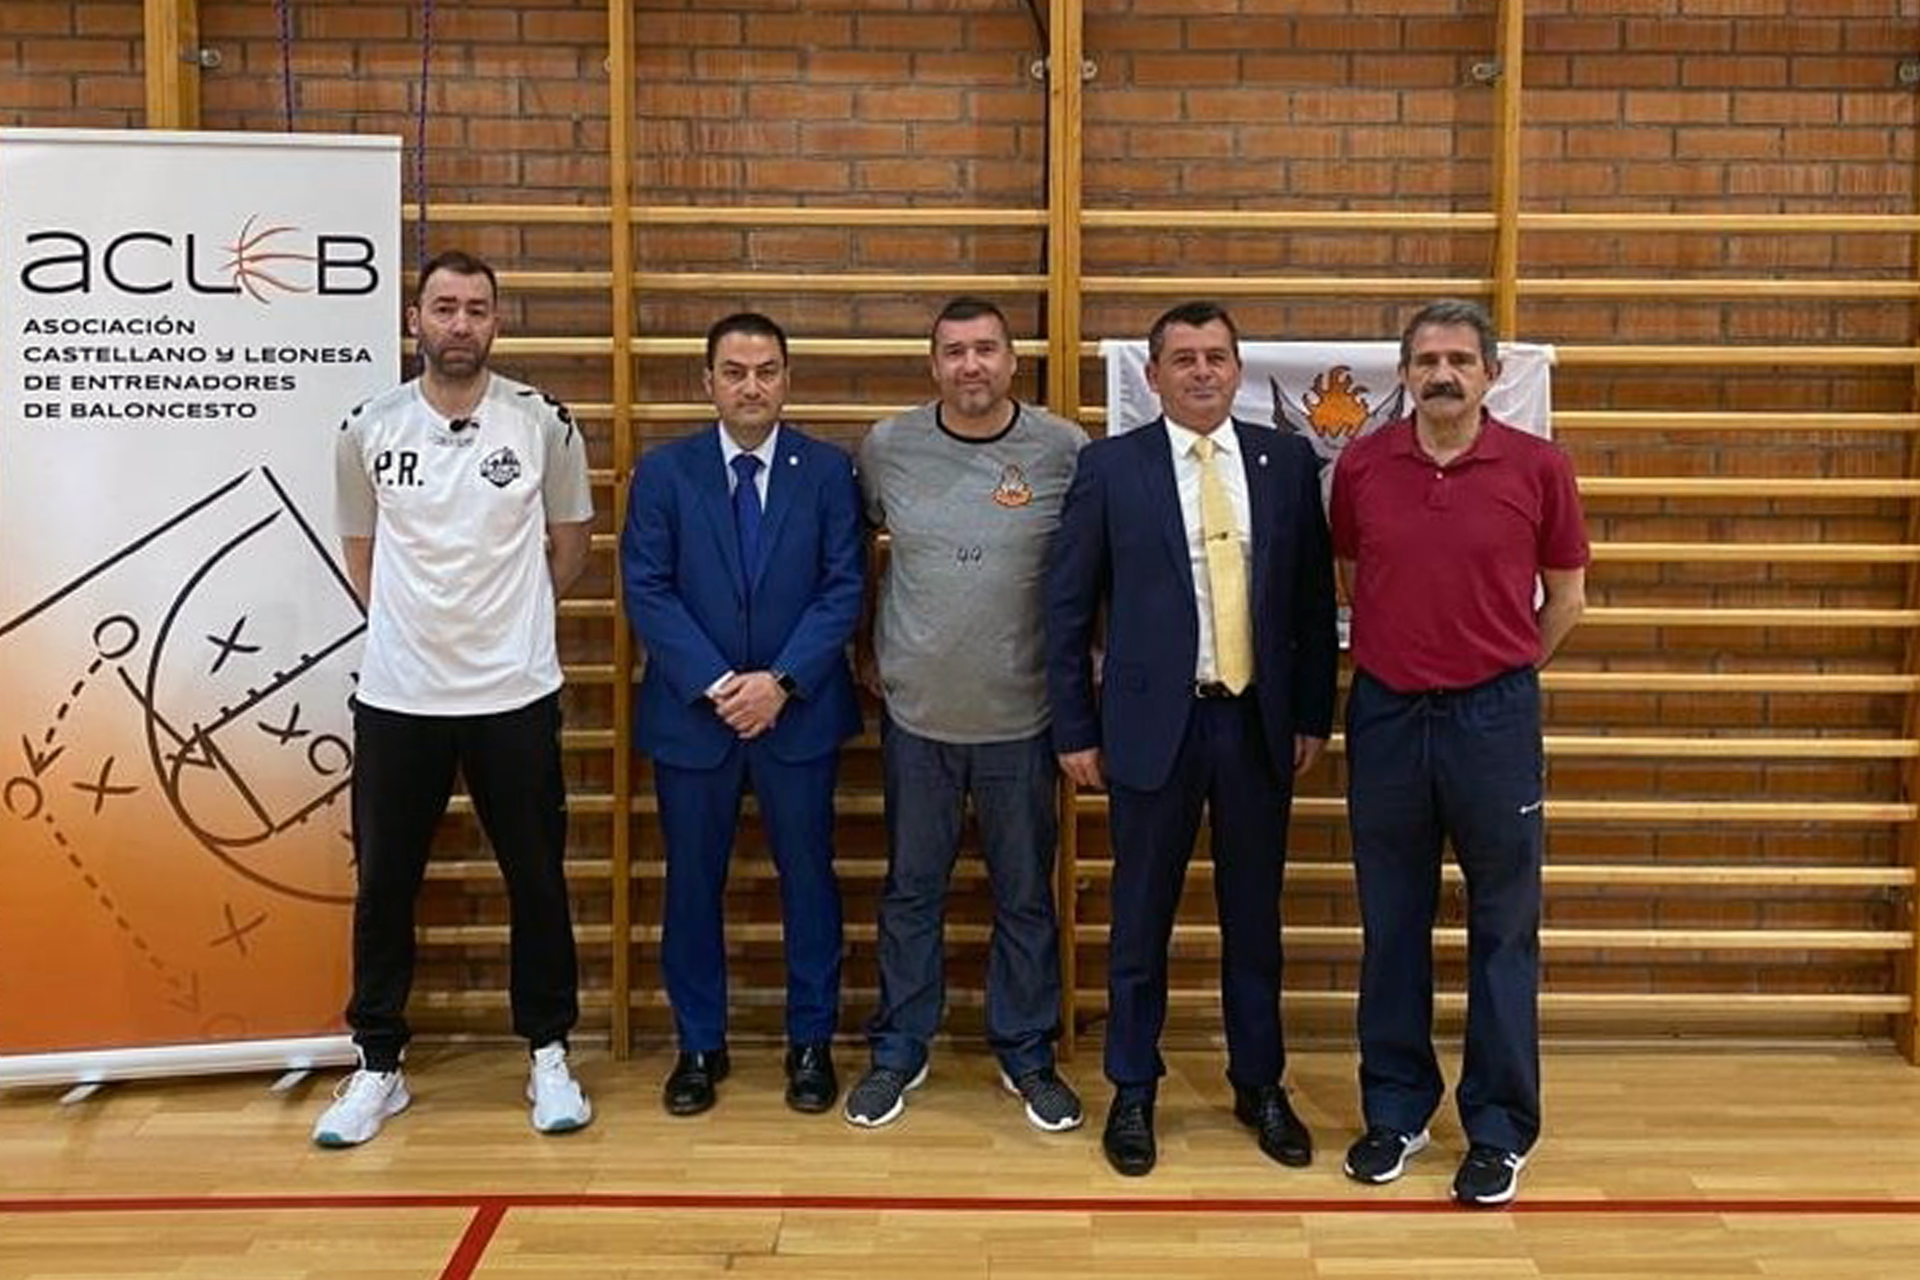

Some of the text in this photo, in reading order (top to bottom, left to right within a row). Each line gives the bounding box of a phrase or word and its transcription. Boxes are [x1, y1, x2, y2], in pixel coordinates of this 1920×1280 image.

[23, 315, 196, 335] ASOCIACIÓN
[23, 346, 208, 363] CASTELLANO
[245, 347, 373, 363] LEONESA
[24, 375, 297, 391] DE ENTRENADORES
[24, 402, 257, 419] DE BALONCESTO
[374, 450, 425, 487] P.R.
